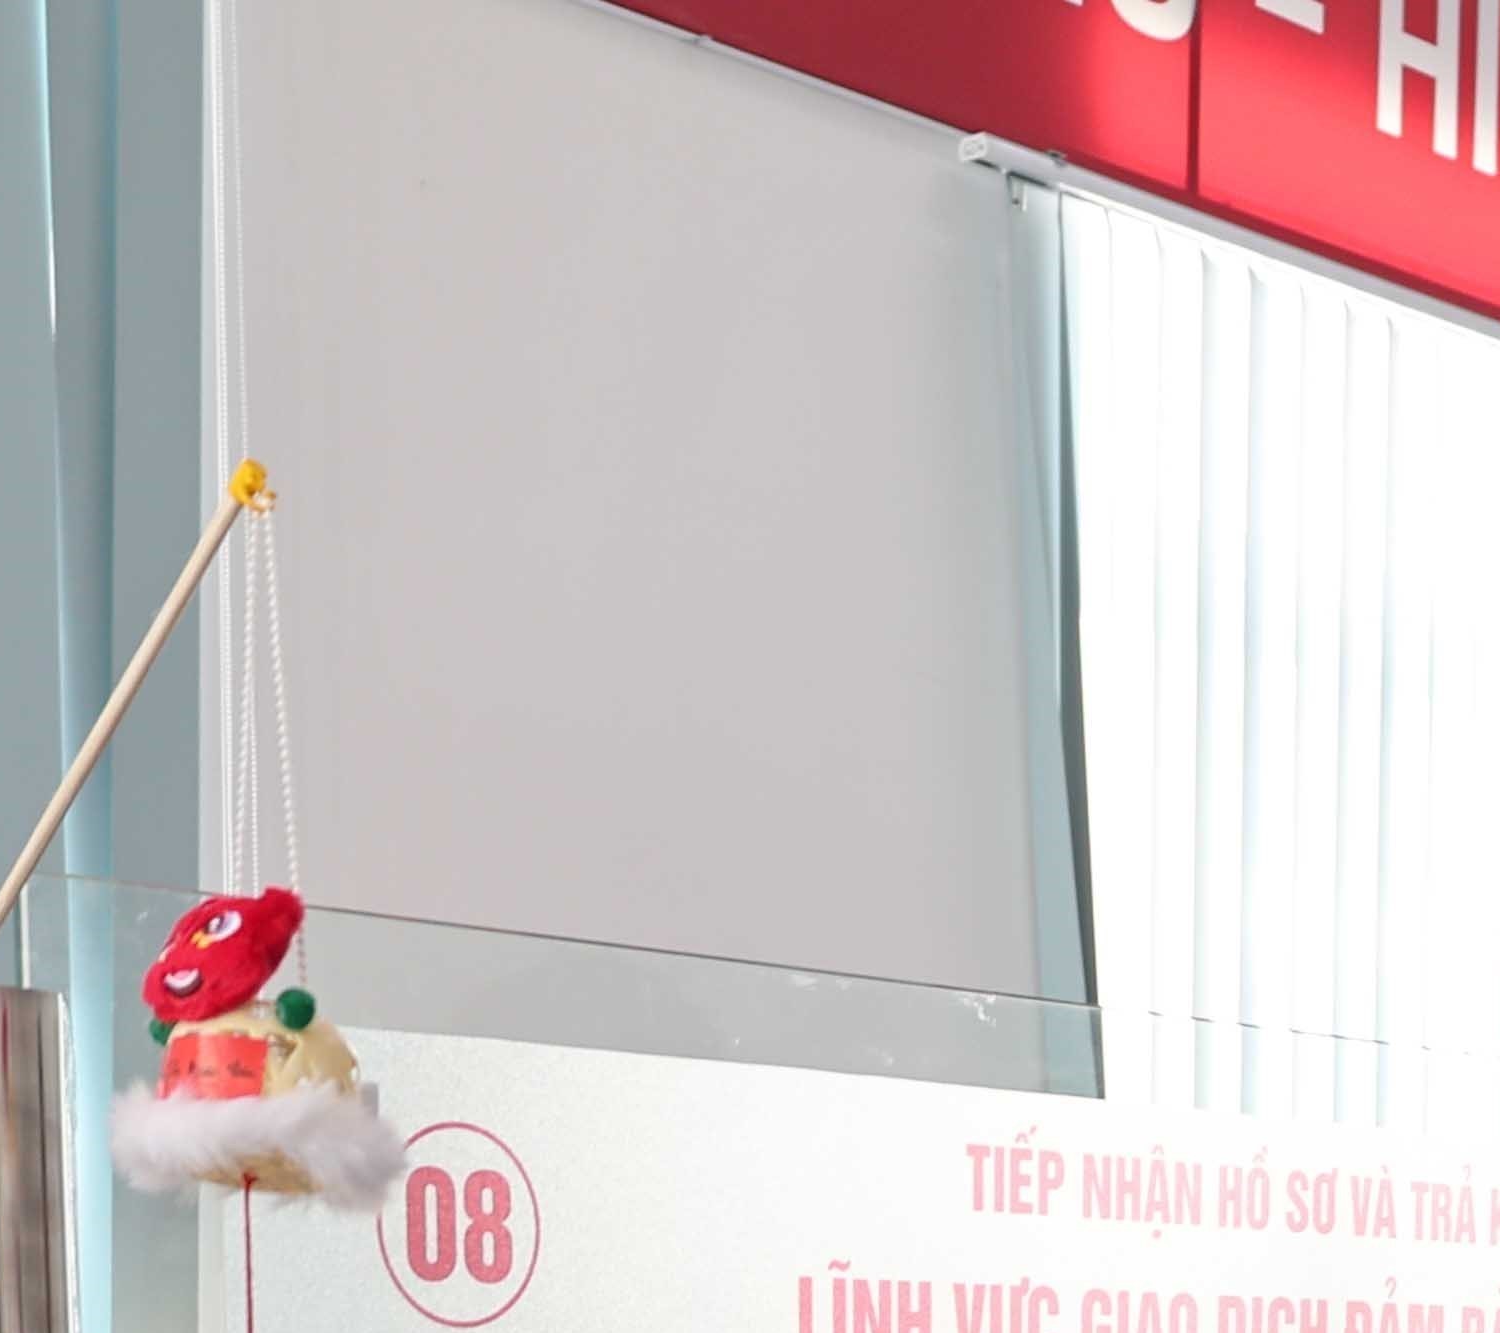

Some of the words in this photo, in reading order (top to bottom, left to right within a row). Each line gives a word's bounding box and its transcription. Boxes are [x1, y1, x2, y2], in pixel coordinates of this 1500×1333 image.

[407, 1165, 512, 1285] 08
[965, 1126, 1065, 1215] TIẾP
[1081, 1145, 1204, 1239] NHẬN
[1219, 1145, 1270, 1231] HỒ
[1286, 1169, 1339, 1234] SƠ
[1350, 1162, 1397, 1239] VÀ
[1411, 1162, 1477, 1246] TRẢ
